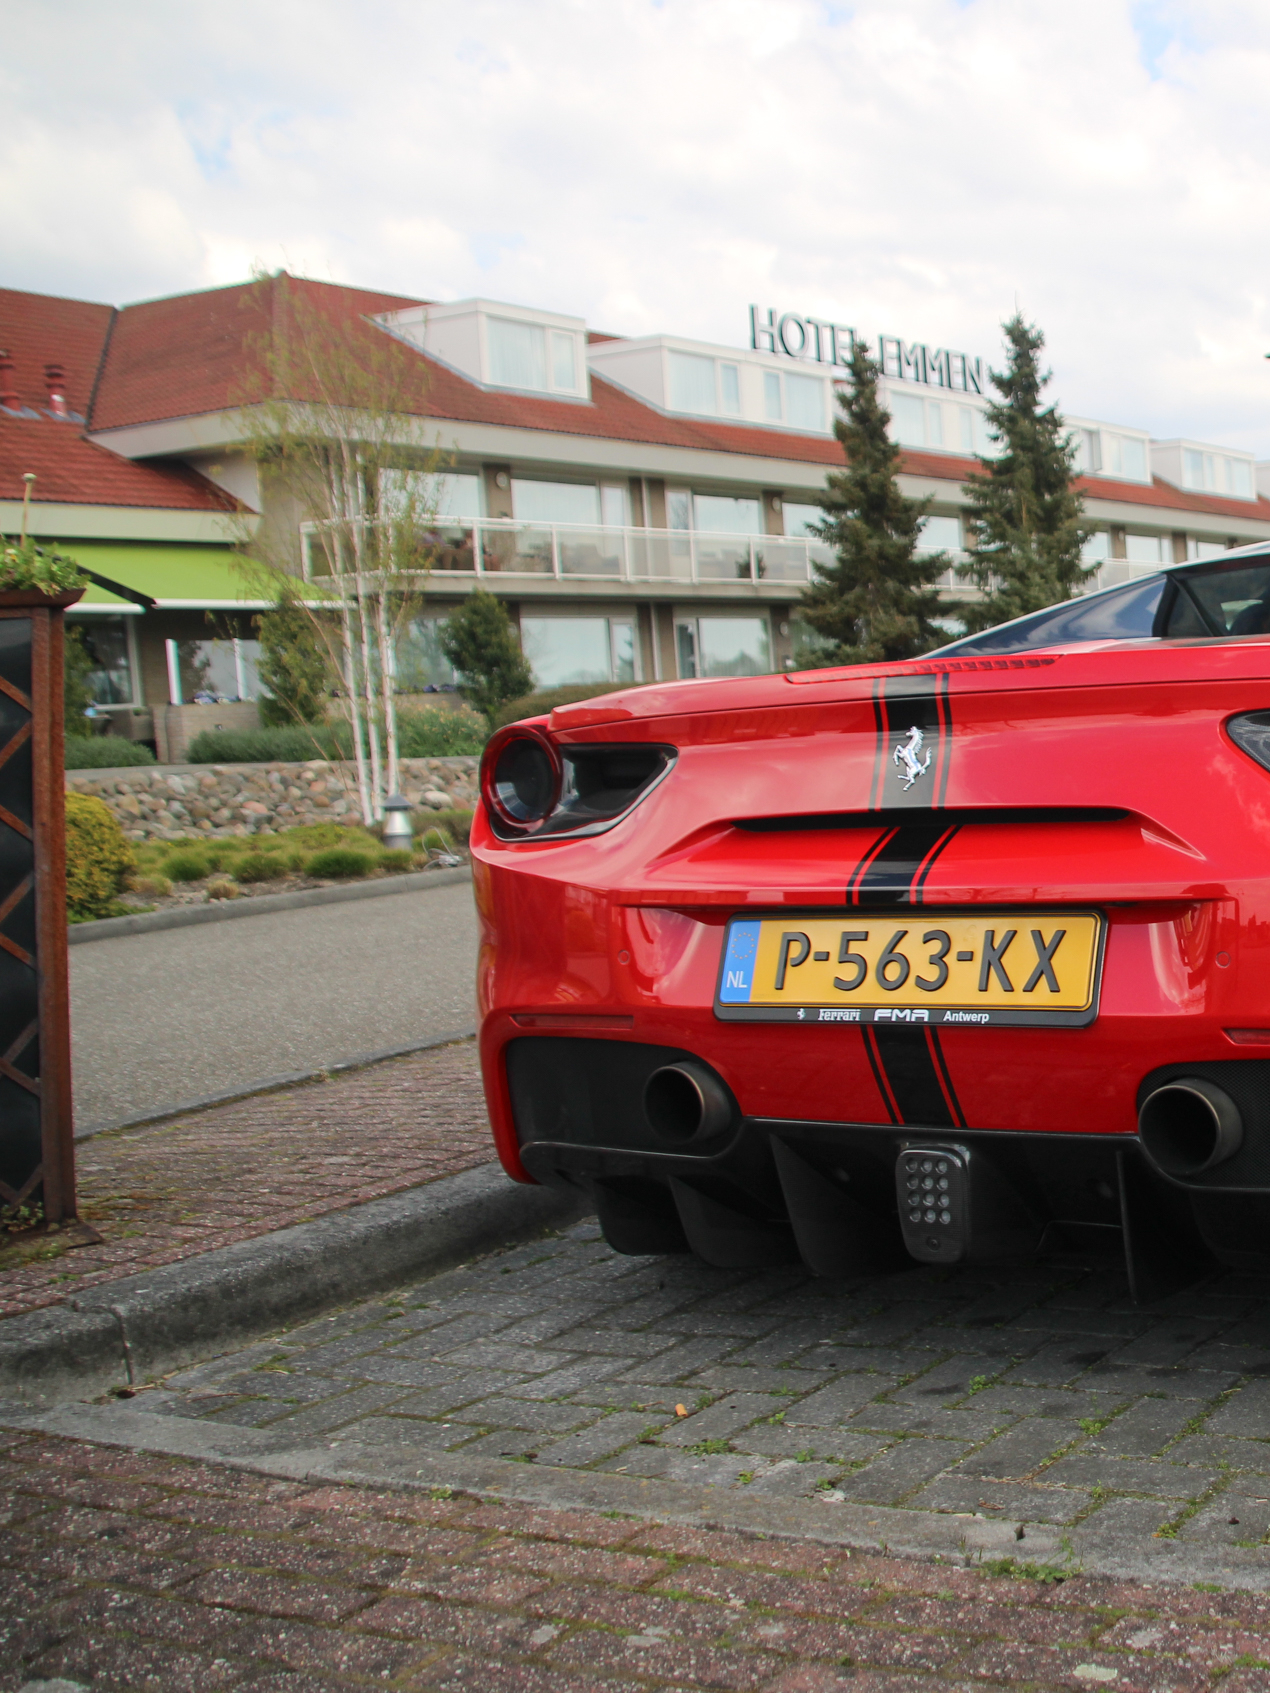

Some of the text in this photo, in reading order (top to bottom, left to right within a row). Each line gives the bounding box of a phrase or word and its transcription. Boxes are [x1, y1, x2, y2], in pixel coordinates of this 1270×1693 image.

[878, 333, 985, 395] EMMEN
[726, 970, 748, 989] NL
[774, 928, 1067, 993] P-563-KX
[817, 1008, 990, 1024] Ferrari FMA Antwerp
